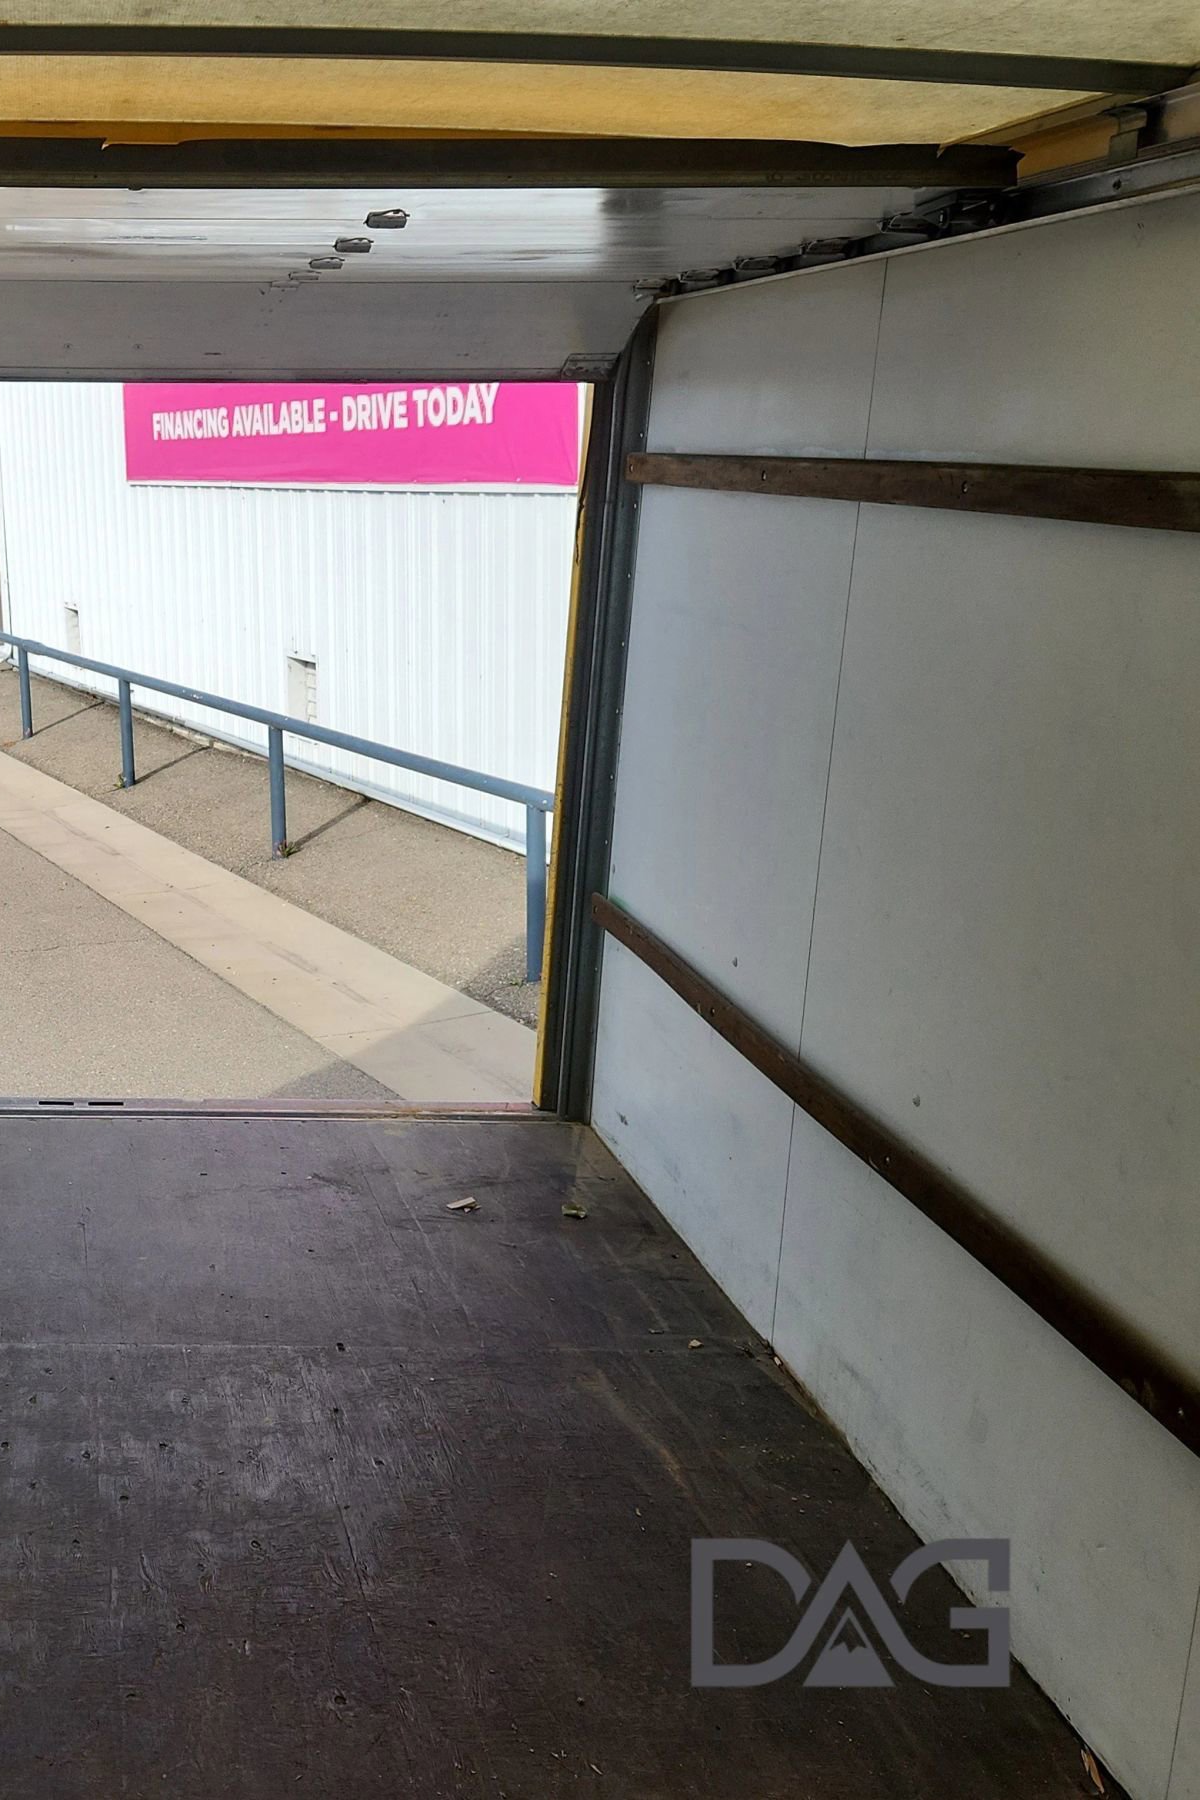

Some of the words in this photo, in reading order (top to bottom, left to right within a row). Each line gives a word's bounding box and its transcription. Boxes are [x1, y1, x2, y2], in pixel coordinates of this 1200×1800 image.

[152, 407, 229, 441] FINANCING
[232, 398, 326, 438] AVAILABLE
[342, 390, 408, 432] DRIVE
[412, 383, 500, 428] TODAY
